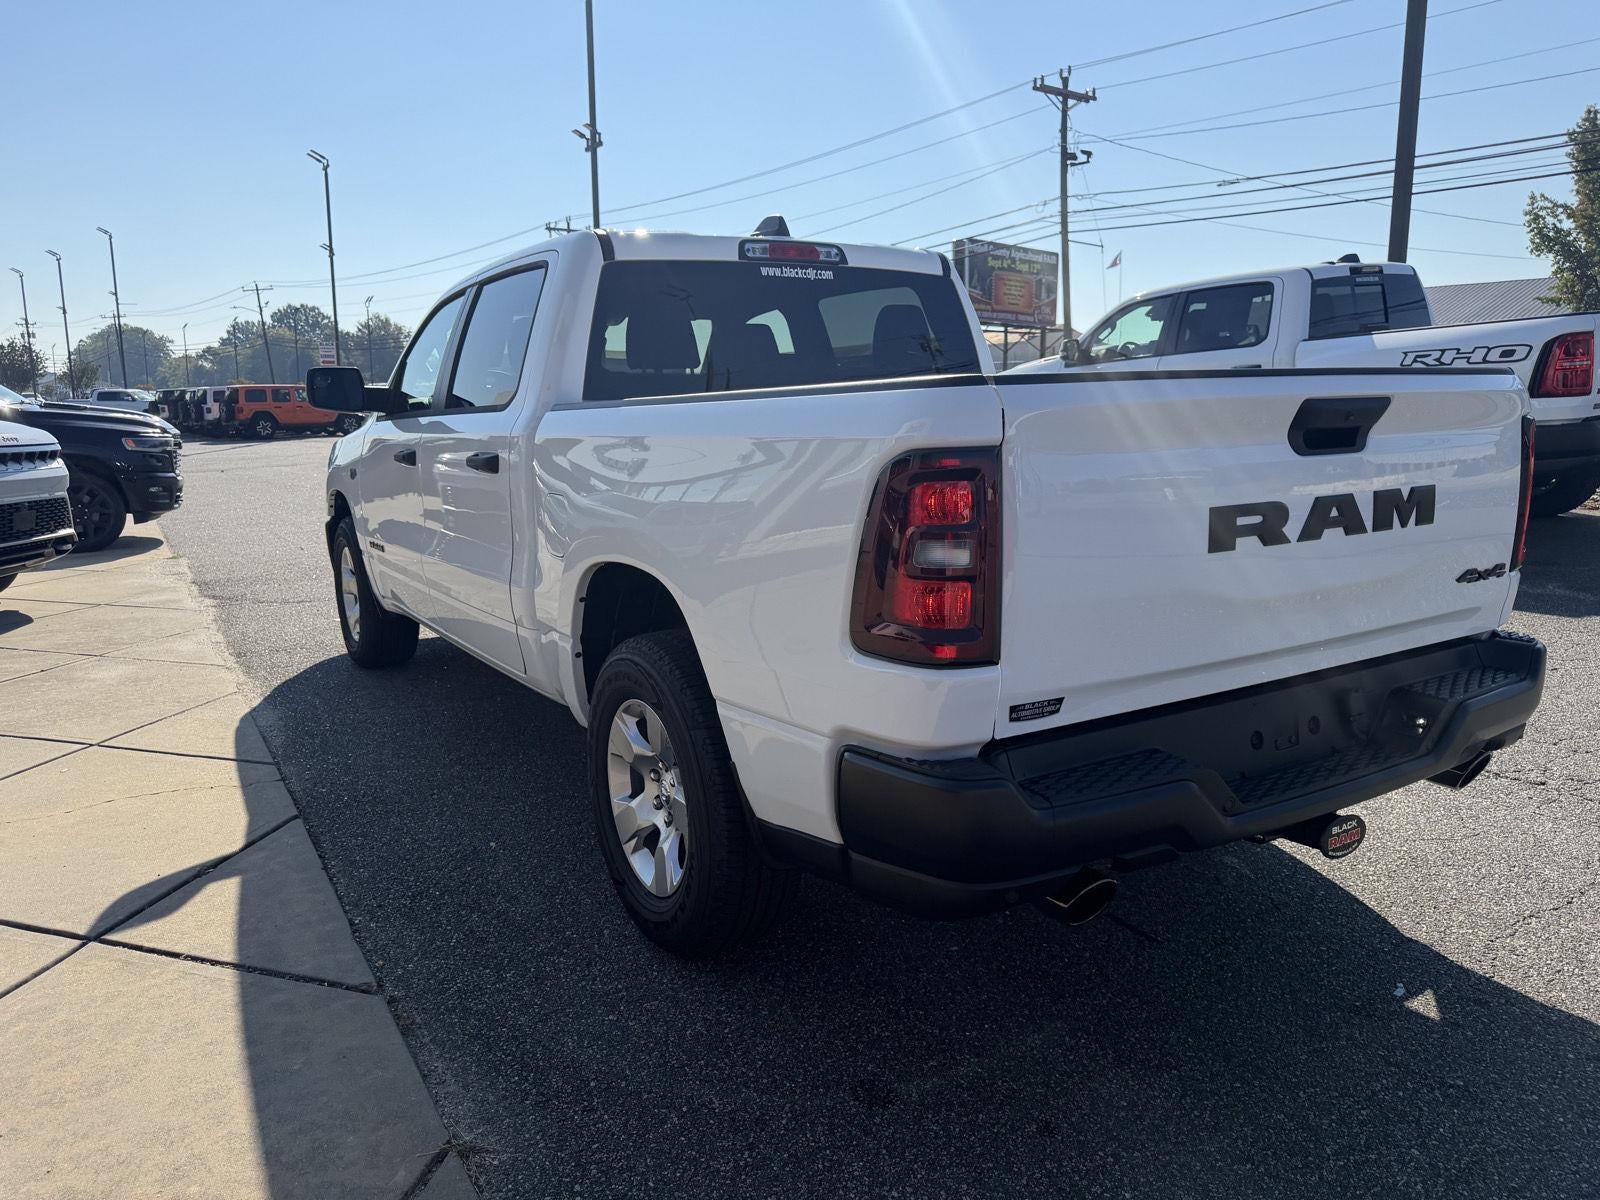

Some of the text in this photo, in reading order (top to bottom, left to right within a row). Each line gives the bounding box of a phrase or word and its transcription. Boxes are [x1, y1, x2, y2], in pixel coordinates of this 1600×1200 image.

[760, 266, 834, 280] www.blackcdjr.com
[1401, 344, 1533, 367] RHO
[1207, 484, 1436, 554] RAM
[1455, 563, 1506, 583] 4x4
[1024, 701, 1049, 710] BLACK
[1332, 820, 1358, 834] BLACK
[1328, 828, 1360, 849] RAM
